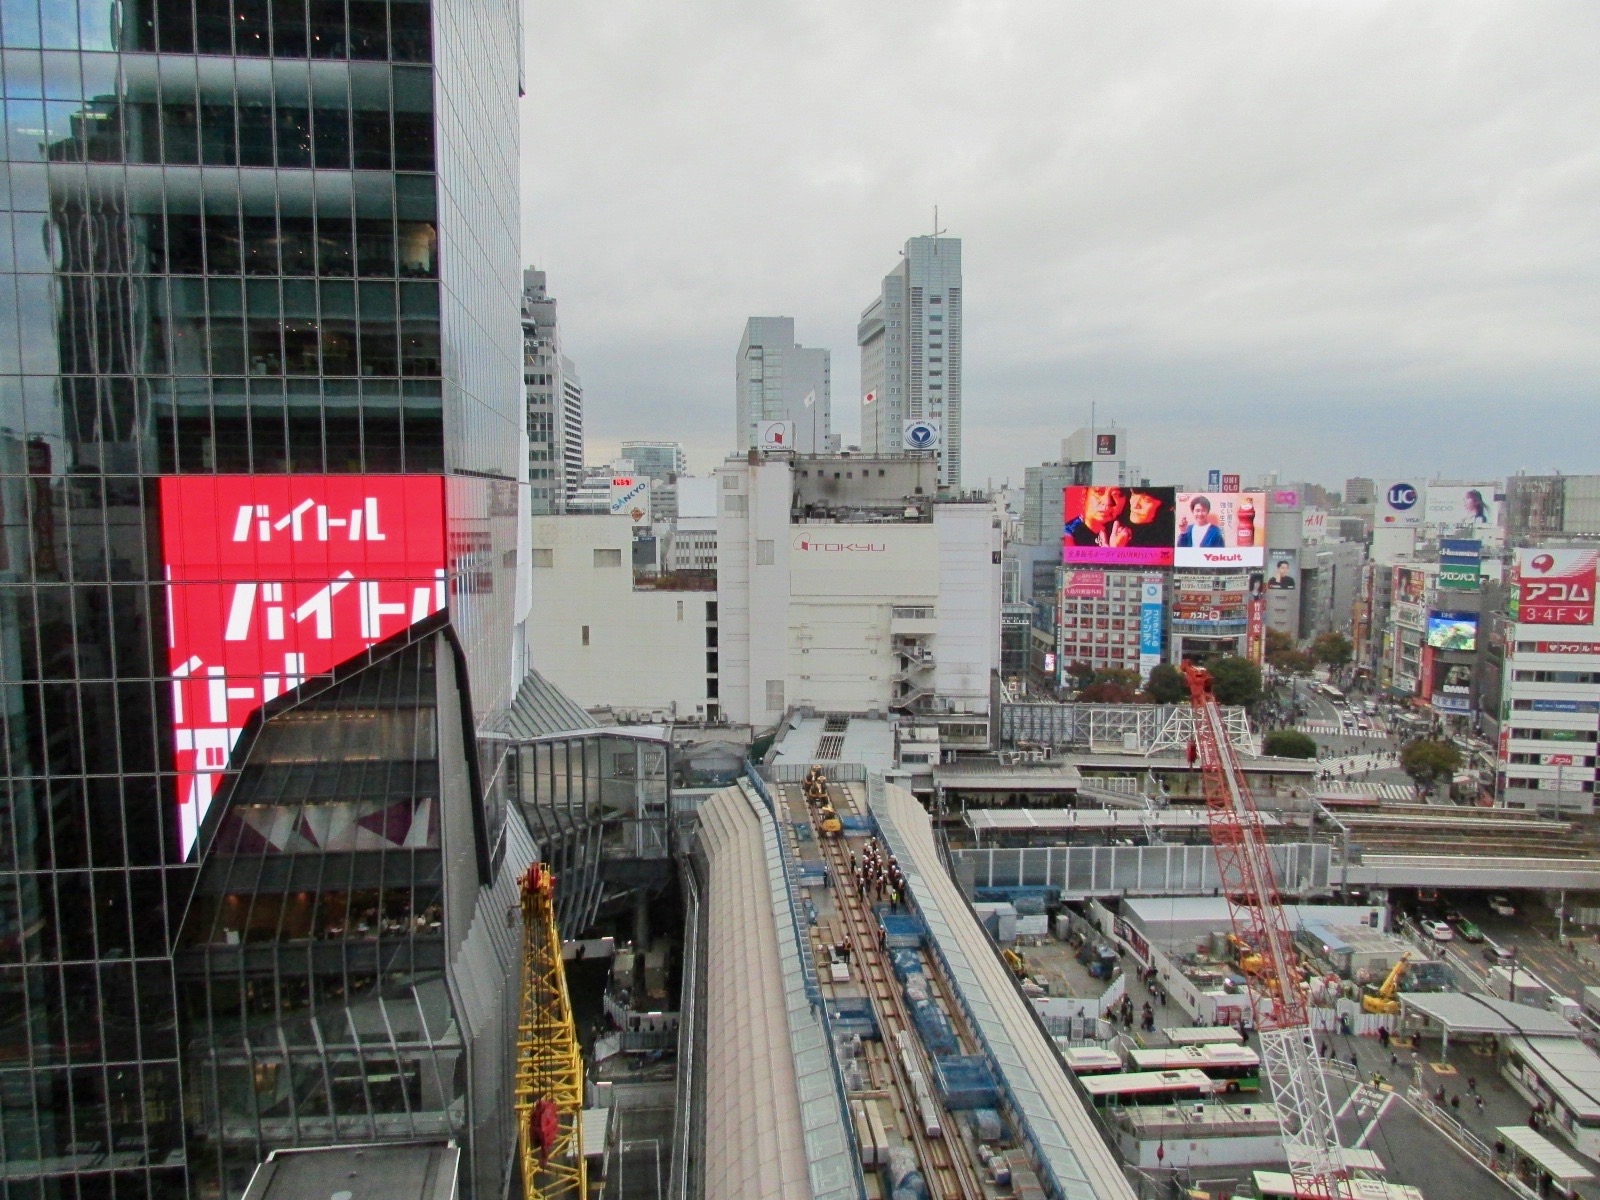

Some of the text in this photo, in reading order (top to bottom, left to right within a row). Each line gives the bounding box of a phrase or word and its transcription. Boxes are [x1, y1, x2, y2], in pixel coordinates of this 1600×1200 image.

[1223, 475, 1238, 484] UNI
[1223, 484, 1239, 493] QLO
[612, 482, 646, 512] SANKYO
[232, 497, 386, 542] バイトル
[809, 543, 886, 552] TOKYU
[1203, 553, 1243, 562] Yakult
[1525, 583, 1590, 601] アコム
[1189, 611, 1209, 619] ガスト
[1559, 644, 1590, 652] アイフル
